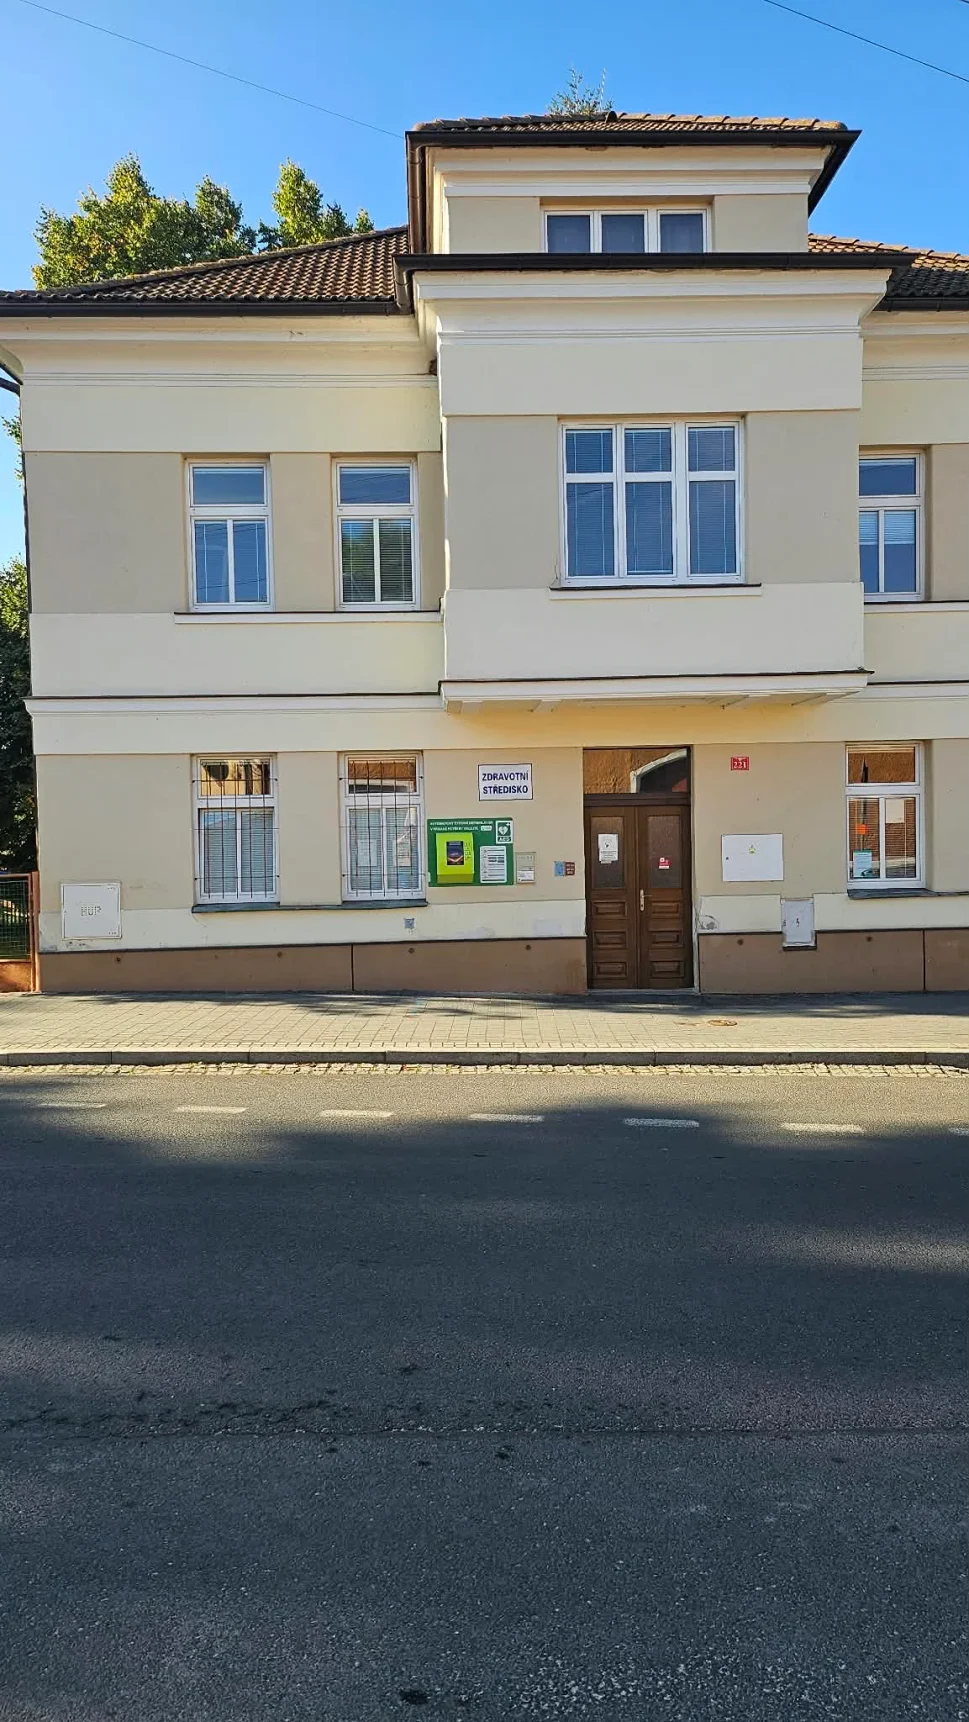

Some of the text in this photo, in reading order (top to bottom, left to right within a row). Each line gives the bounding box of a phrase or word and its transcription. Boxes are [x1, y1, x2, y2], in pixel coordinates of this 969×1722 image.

[481, 769, 529, 781] ZDRAVOTNÍ
[482, 784, 529, 795] STŘEDISKO
[81, 905, 102, 916] HUP
